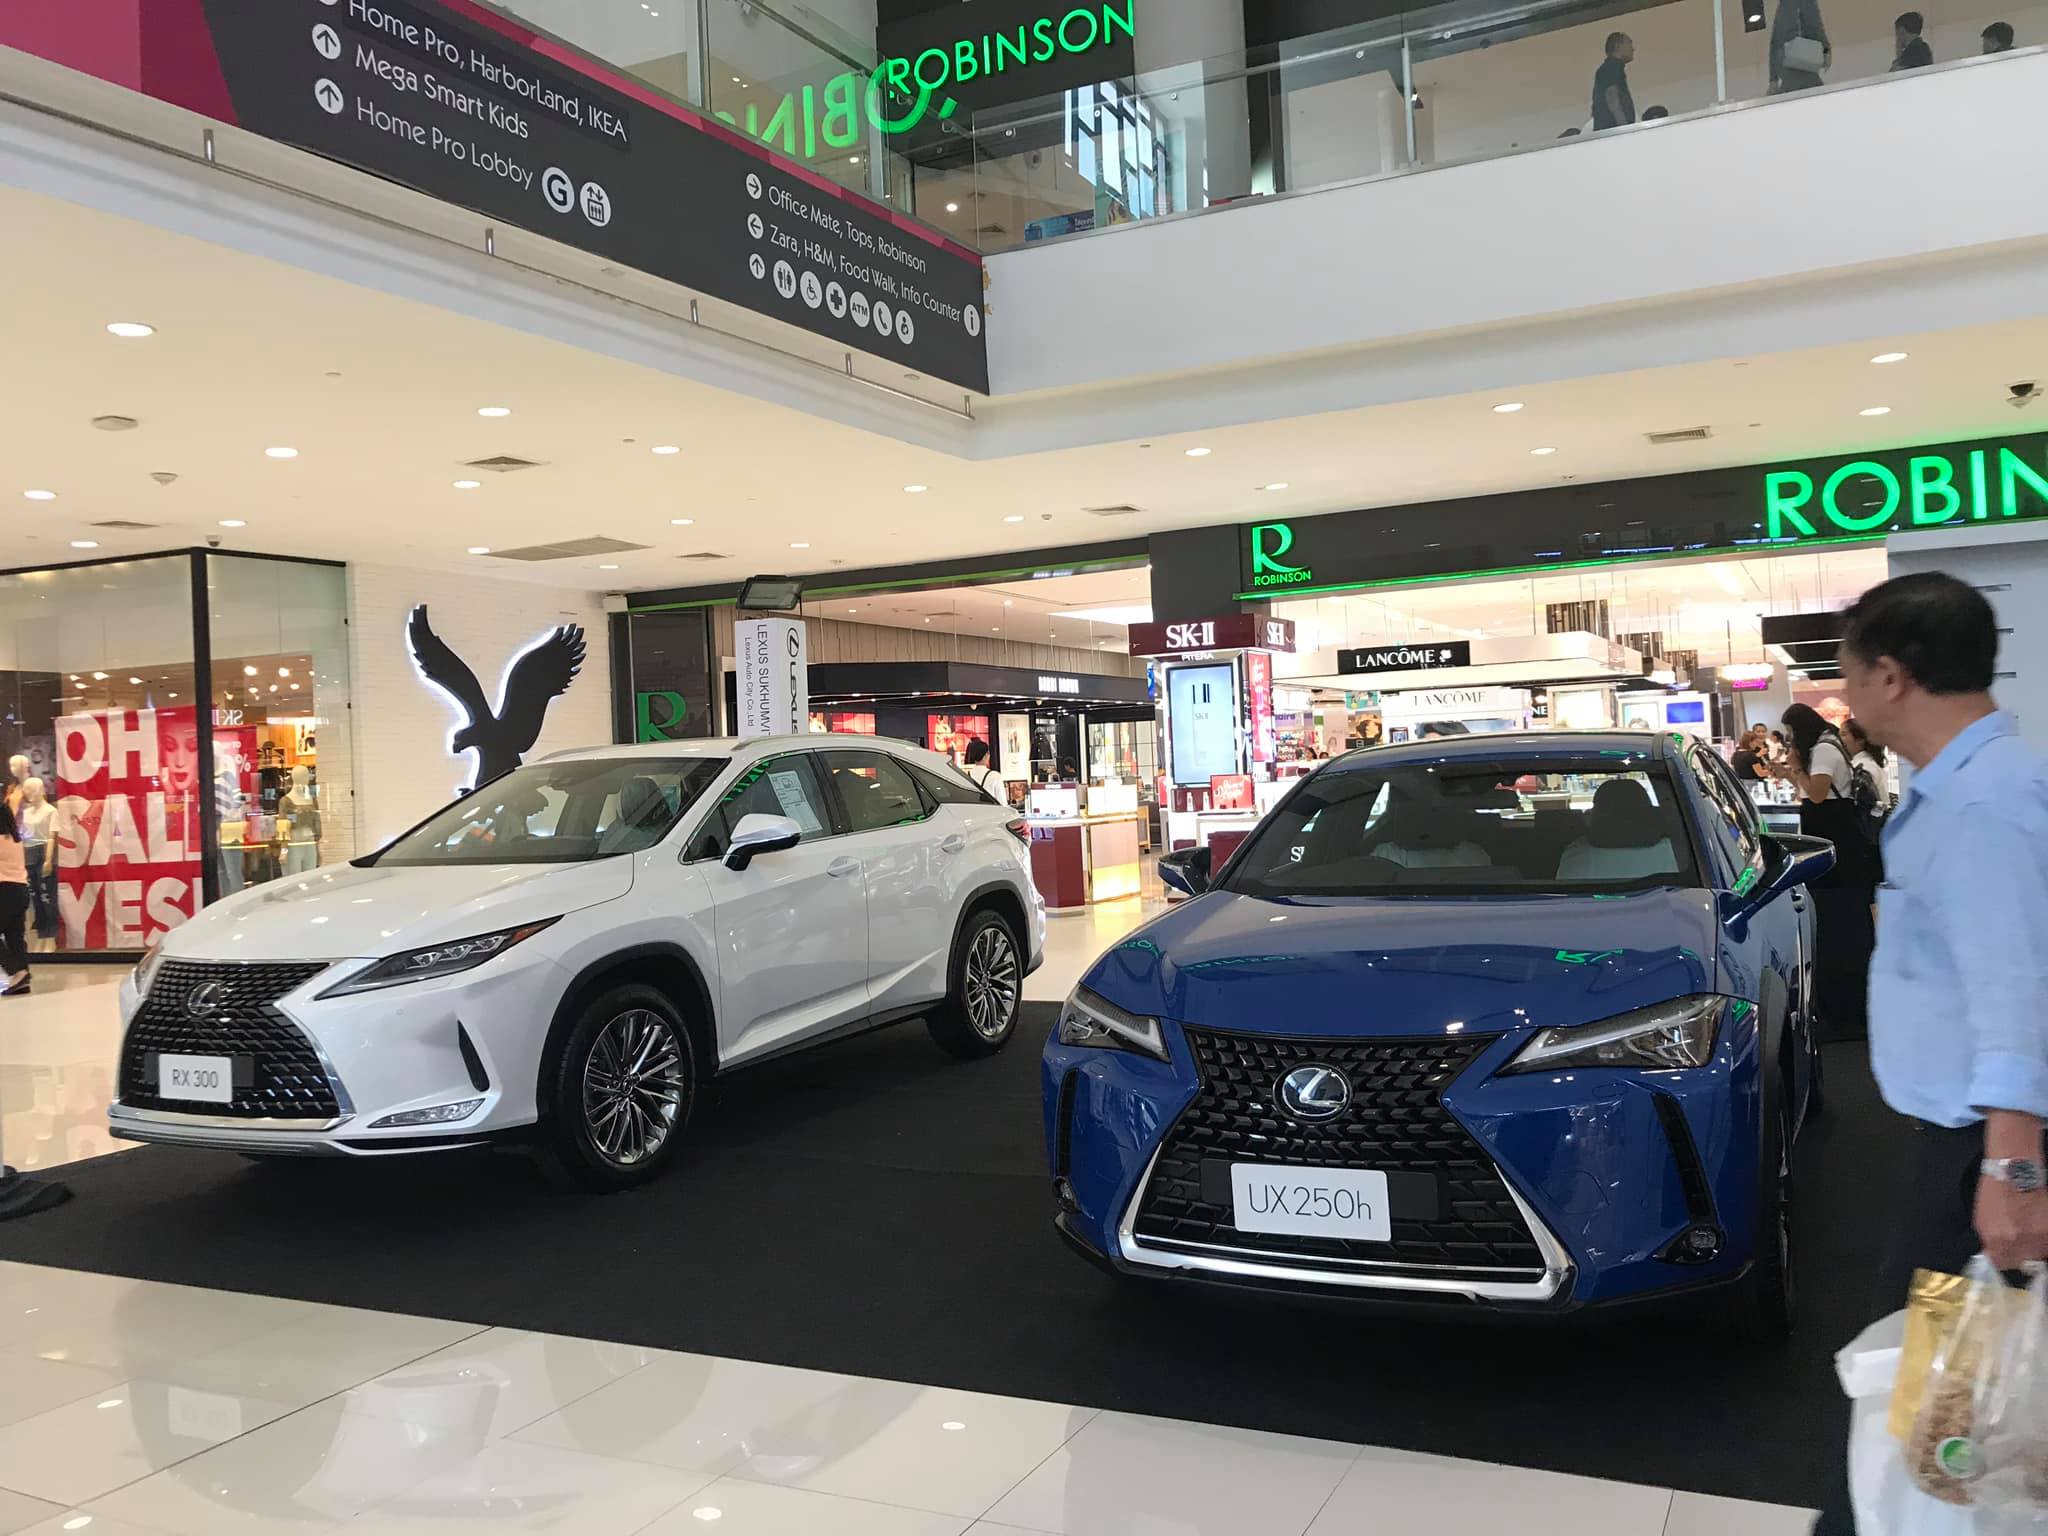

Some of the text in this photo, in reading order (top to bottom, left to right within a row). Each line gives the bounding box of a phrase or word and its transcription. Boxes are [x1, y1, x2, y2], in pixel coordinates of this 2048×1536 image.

[888, 0, 1135, 98] ROBINSON
[349, 0, 419, 45] Home
[425, 27, 466, 69] Pro,
[588, 104, 628, 142] IKEA
[356, 44, 529, 139] Mega Smart Kids
[357, 96, 426, 145] Home
[432, 127, 466, 160] Pro
[471, 140, 533, 191] Lobby
[768, 185, 926, 273] Office Mate, Tops, Robinson
[770, 224, 800, 257] Zara,
[804, 242, 837, 272] H&M,
[840, 255, 869, 283] Food
[871, 268, 899, 299] Walk,
[901, 284, 921, 305] Info
[922, 292, 961, 322] Counter
[851, 302, 869, 318] ATM
[1254, 570, 1311, 586] ROBINSON
[757, 624, 768, 665] LEXUS
[1166, 621, 1215, 649] SK-II
[745, 662, 753, 680] Auto
[1355, 648, 1435, 668] LANCÔME
[745, 681, 754, 698] City
[172, 1068, 219, 1089] RX 300
[1248, 1183, 1372, 1220] UX 250h
